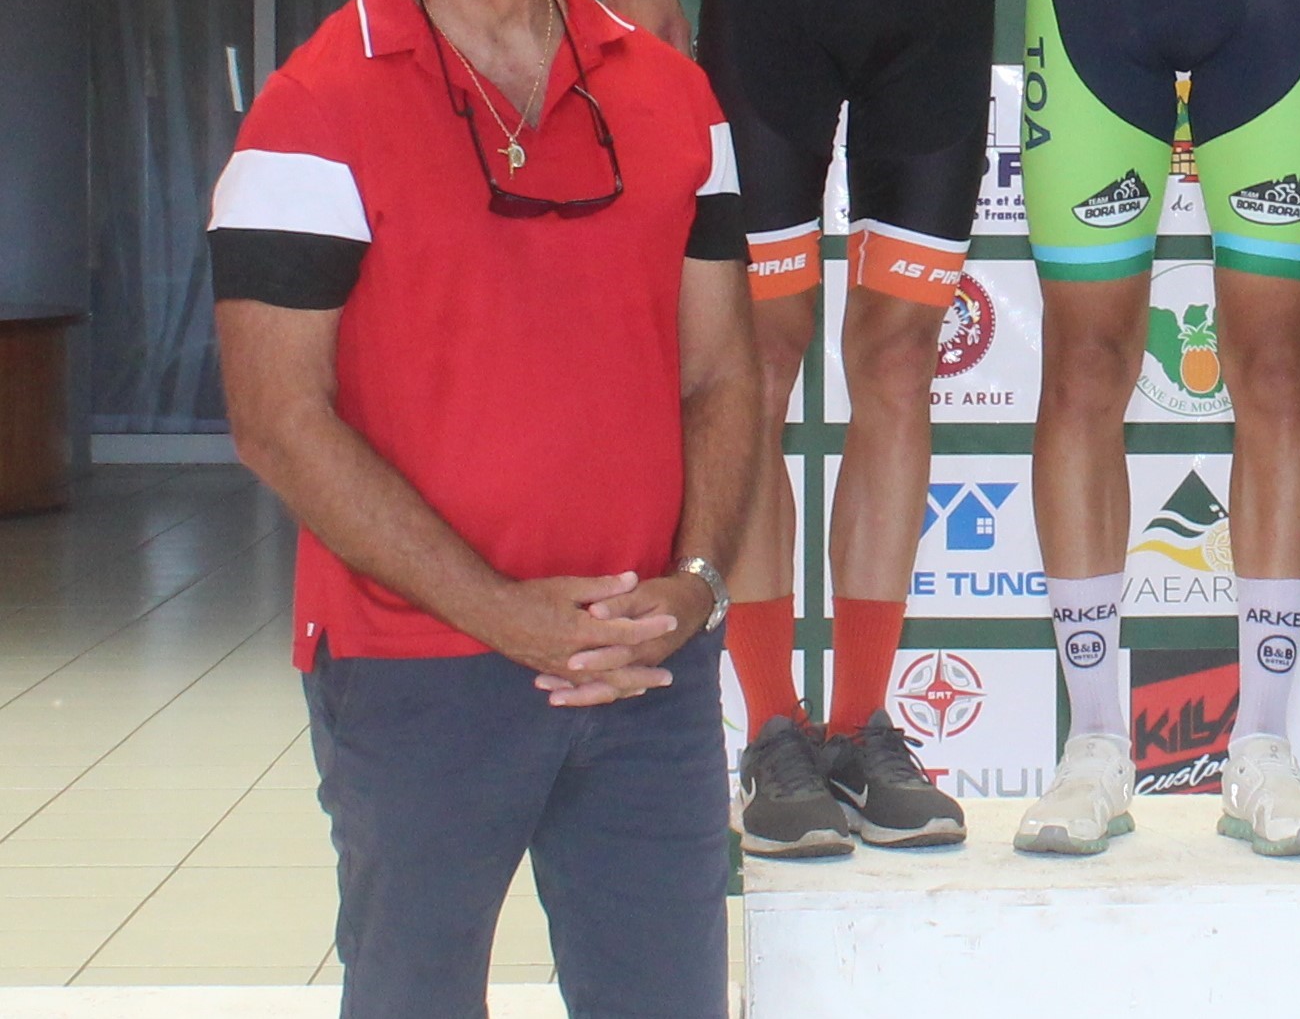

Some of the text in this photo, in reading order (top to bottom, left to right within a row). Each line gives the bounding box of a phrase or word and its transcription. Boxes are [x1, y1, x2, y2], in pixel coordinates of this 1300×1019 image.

[1025, 36, 1052, 150] TOA
[1085, 199, 1141, 219] BORA BORA
[1236, 199, 1300, 218] BORA BORA
[889, 259, 925, 278] AS
[962, 392, 1015, 406] ARUE
[1168, 397, 1186, 411] DE
[946, 572, 1049, 596] TUNG
[1053, 604, 1118, 623] ARKEA
[1070, 640, 1102, 654] B&B
[1263, 644, 1293, 659] B&B
